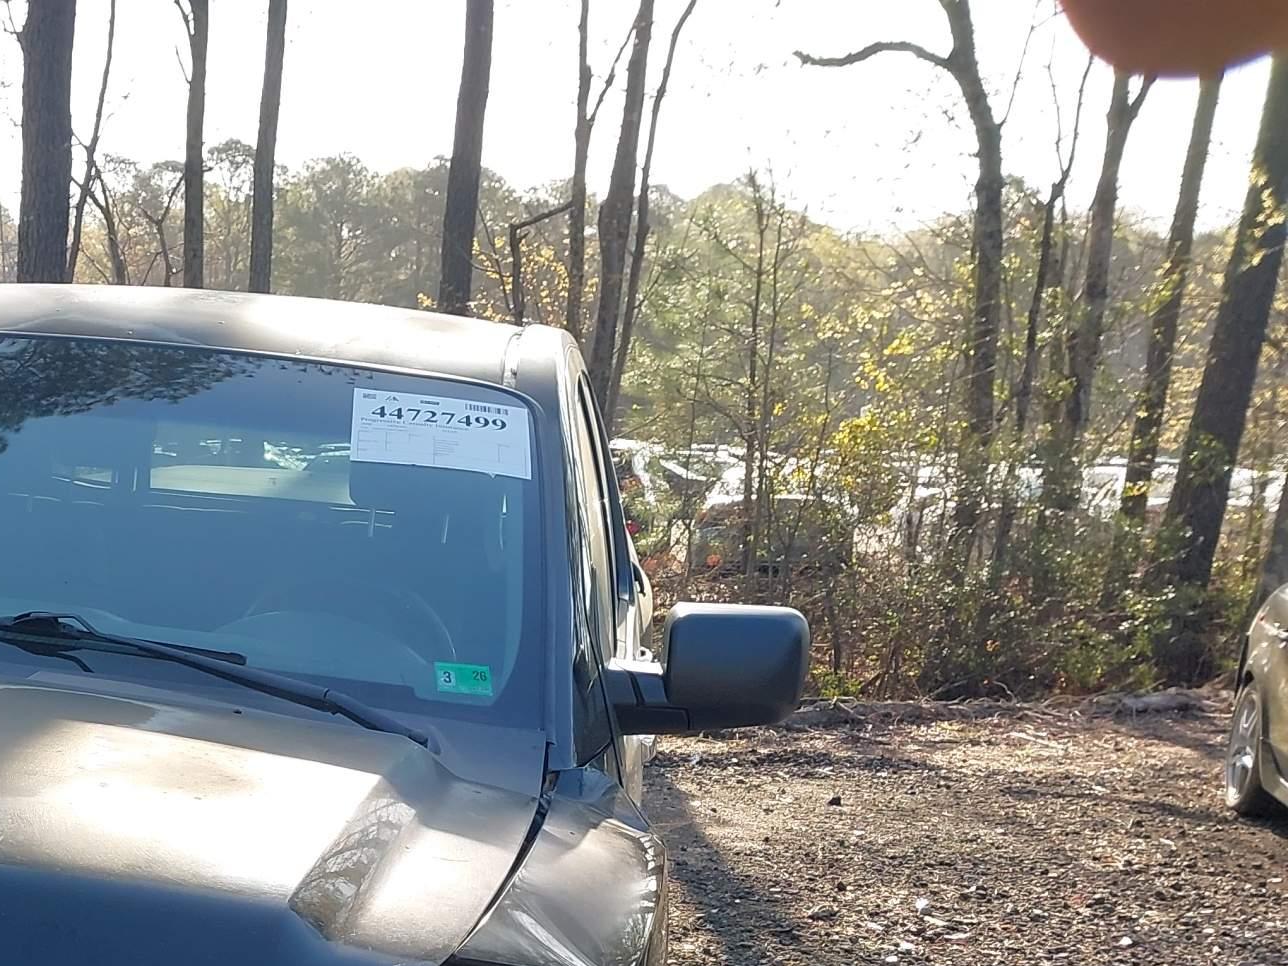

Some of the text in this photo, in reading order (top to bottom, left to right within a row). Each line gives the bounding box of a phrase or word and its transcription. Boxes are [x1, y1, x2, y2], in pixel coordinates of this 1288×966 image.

[370, 405, 508, 432] 44727499
[442, 670, 488, 684] 3 26
